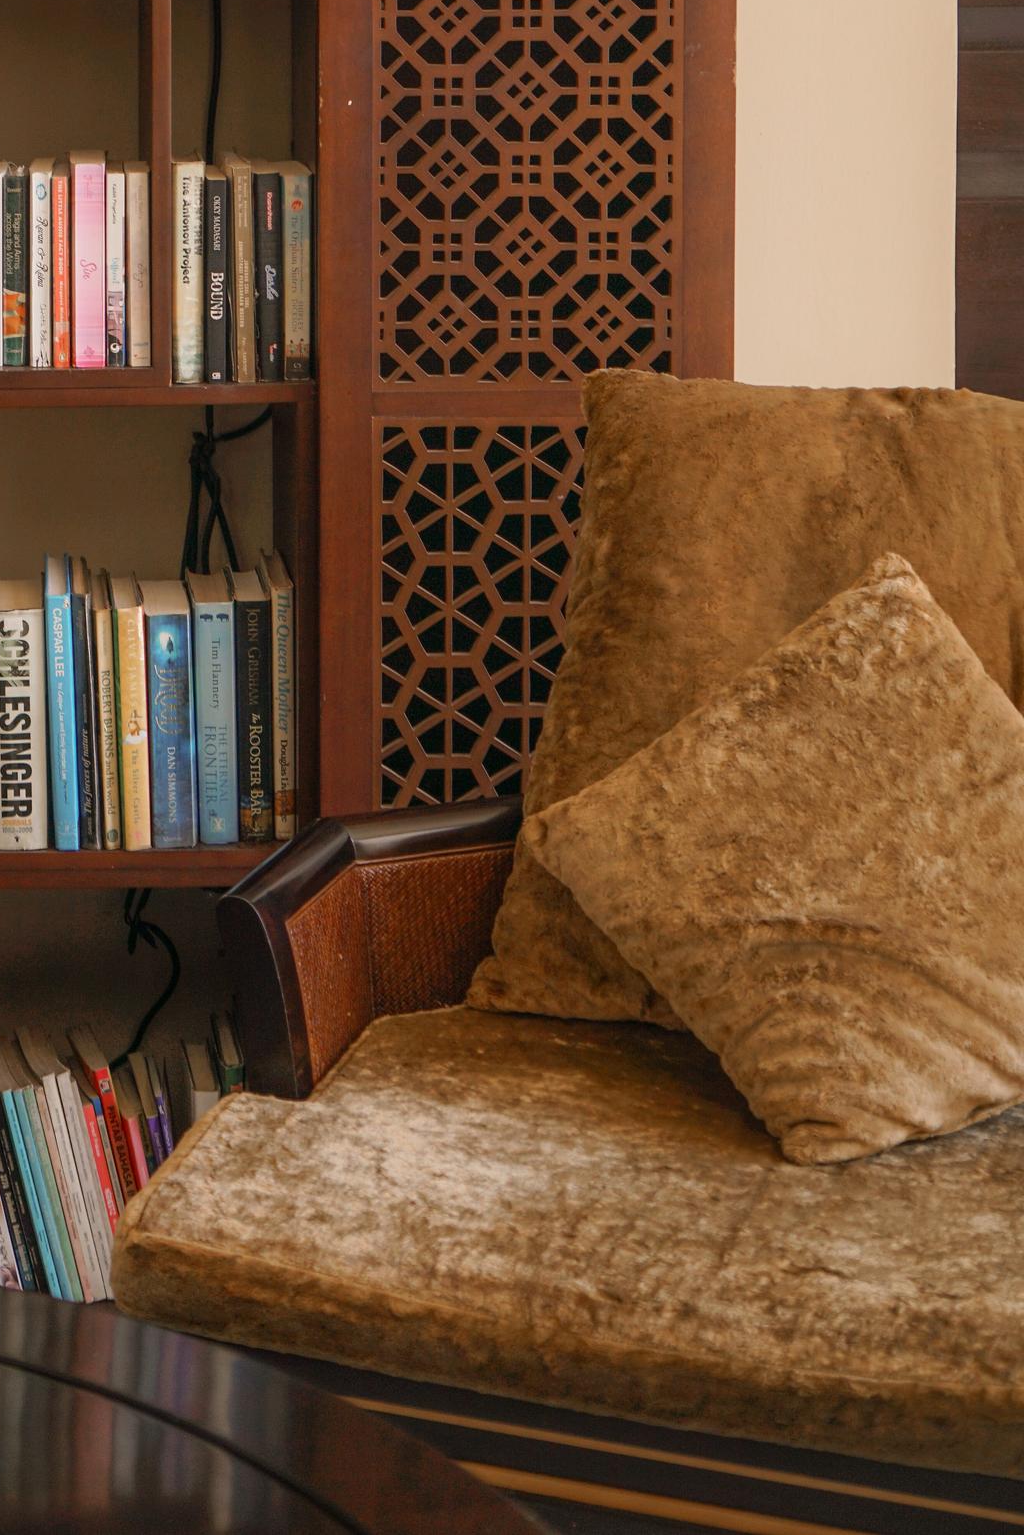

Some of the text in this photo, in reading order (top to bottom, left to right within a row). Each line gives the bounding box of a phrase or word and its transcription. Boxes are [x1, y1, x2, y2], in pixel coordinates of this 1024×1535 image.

[210, 272, 224, 319] BOUND
[53, 608, 64, 677] CASPAR LEE
[210, 639, 222, 709] Tim Flannery
[277, 593, 292, 734] The Queen Mother
[101, 670, 114, 757] ROBERT BURNS
[167, 746, 176, 823] DAN SIMMONS
[204, 726, 217, 803] FRONTIER
[219, 725, 227, 801] THE ETERNAL
[250, 713, 263, 815] The ROOSTER BAR
